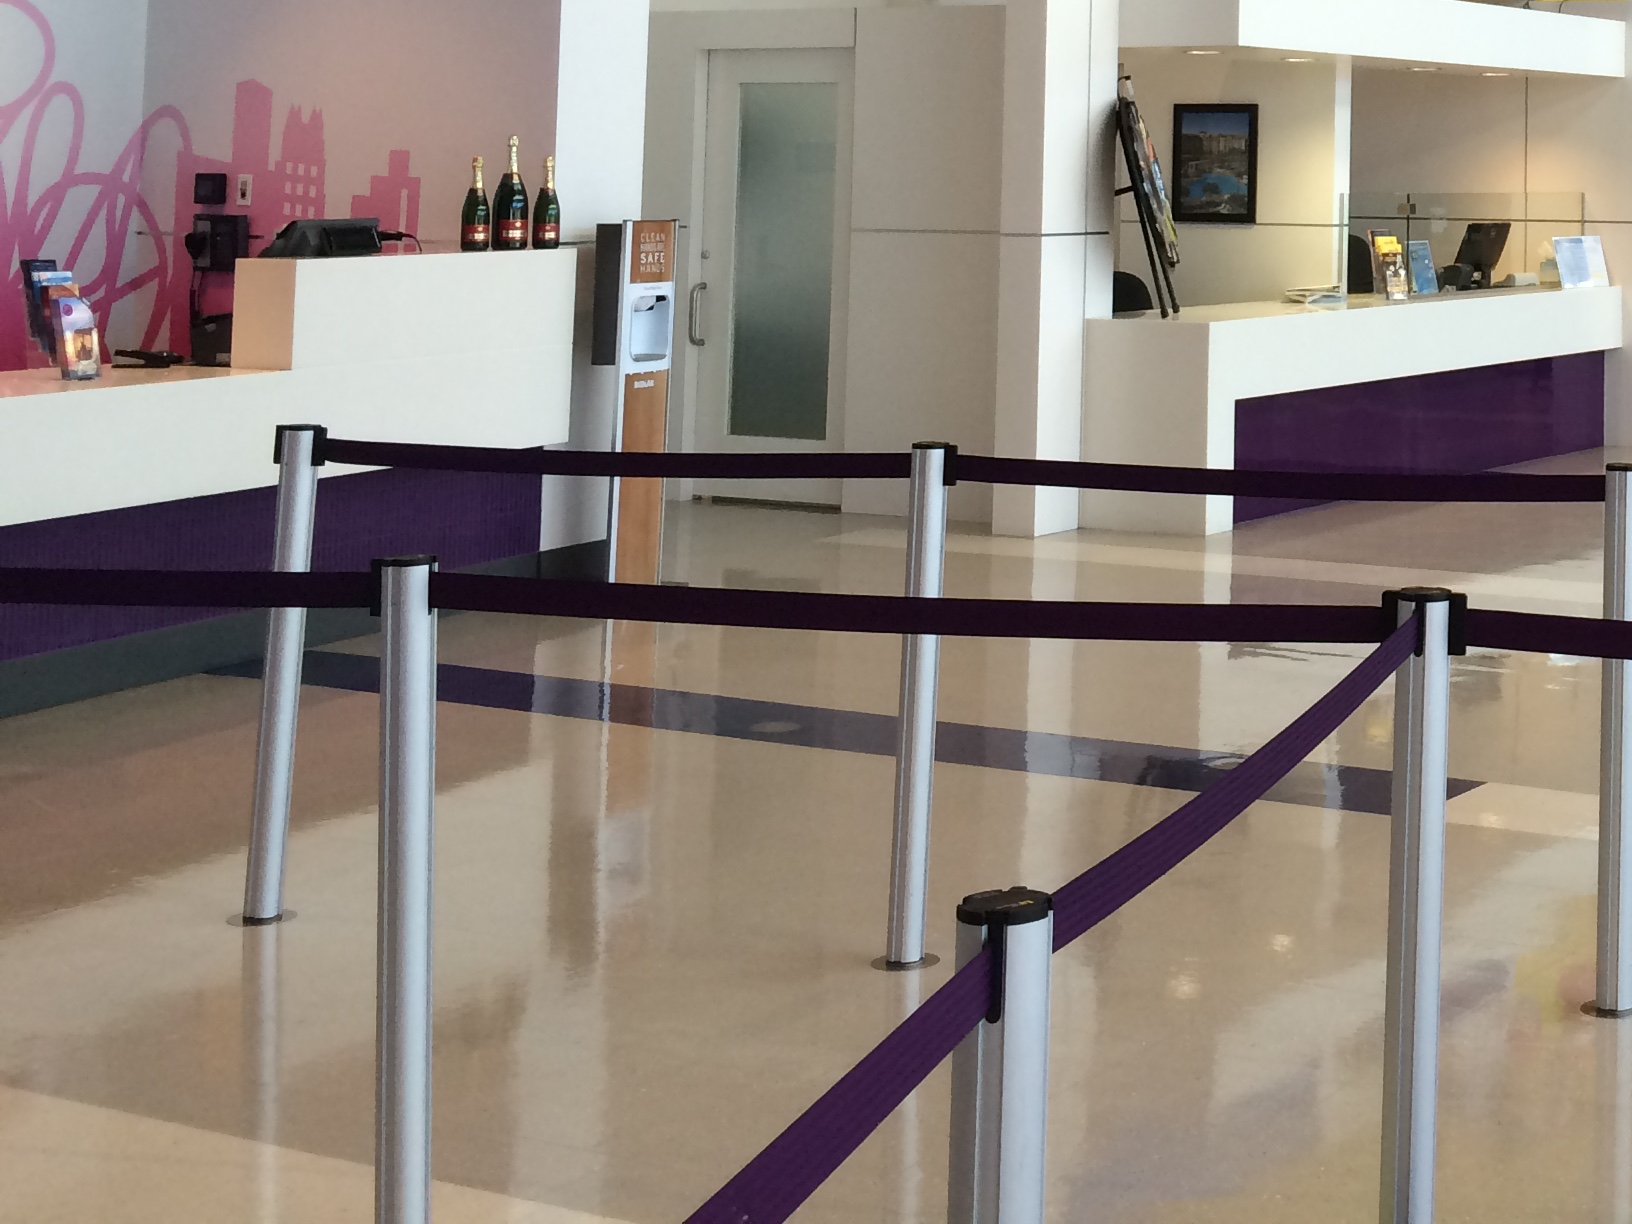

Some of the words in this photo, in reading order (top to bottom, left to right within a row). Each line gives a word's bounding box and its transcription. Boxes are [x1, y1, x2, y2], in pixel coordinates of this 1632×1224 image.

[640, 232, 666, 243] CLEAN
[640, 252, 665, 264] SAFE
[640, 264, 665, 274] HANDS
